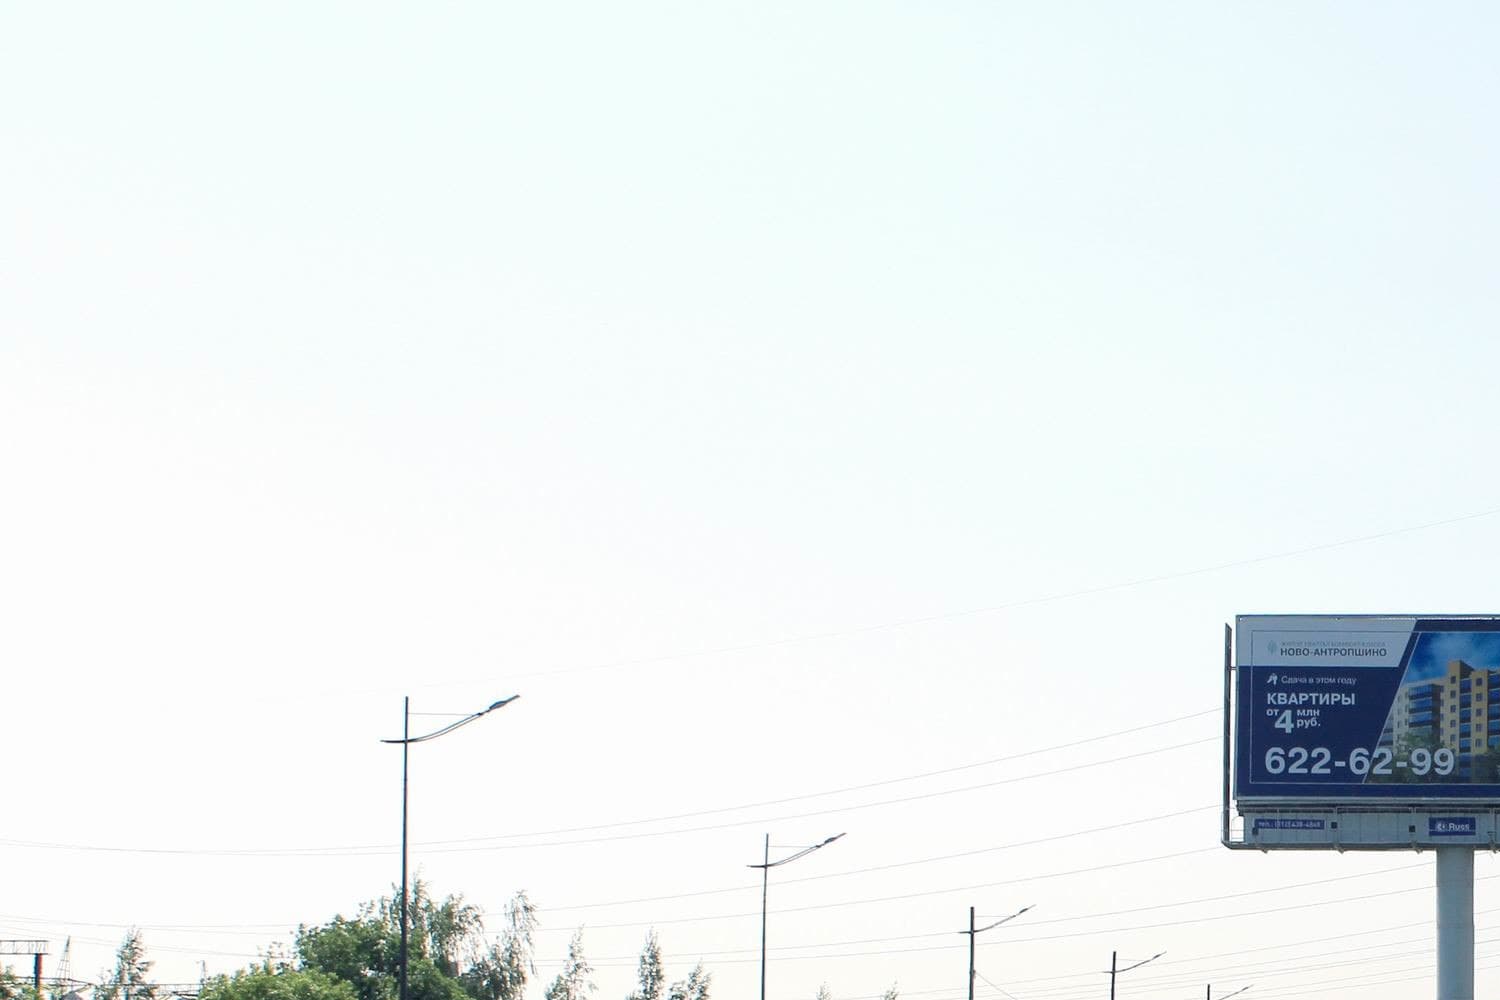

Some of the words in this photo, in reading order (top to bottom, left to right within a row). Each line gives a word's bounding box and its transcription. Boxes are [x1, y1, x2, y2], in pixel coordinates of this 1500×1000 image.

[1280, 647, 1387, 657] НОВО-АНТРОПШИНО
[1281, 675, 1307, 684] Сдача
[1337, 677, 1357, 685] году
[1267, 692, 1356, 705] КВАРТИРЫ
[1266, 708, 1279, 717] от
[1274, 709, 1294, 733] 4
[1296, 708, 1321, 716] млн
[1296, 717, 1321, 728] руб.
[1265, 747, 1455, 776] 622-62-99
